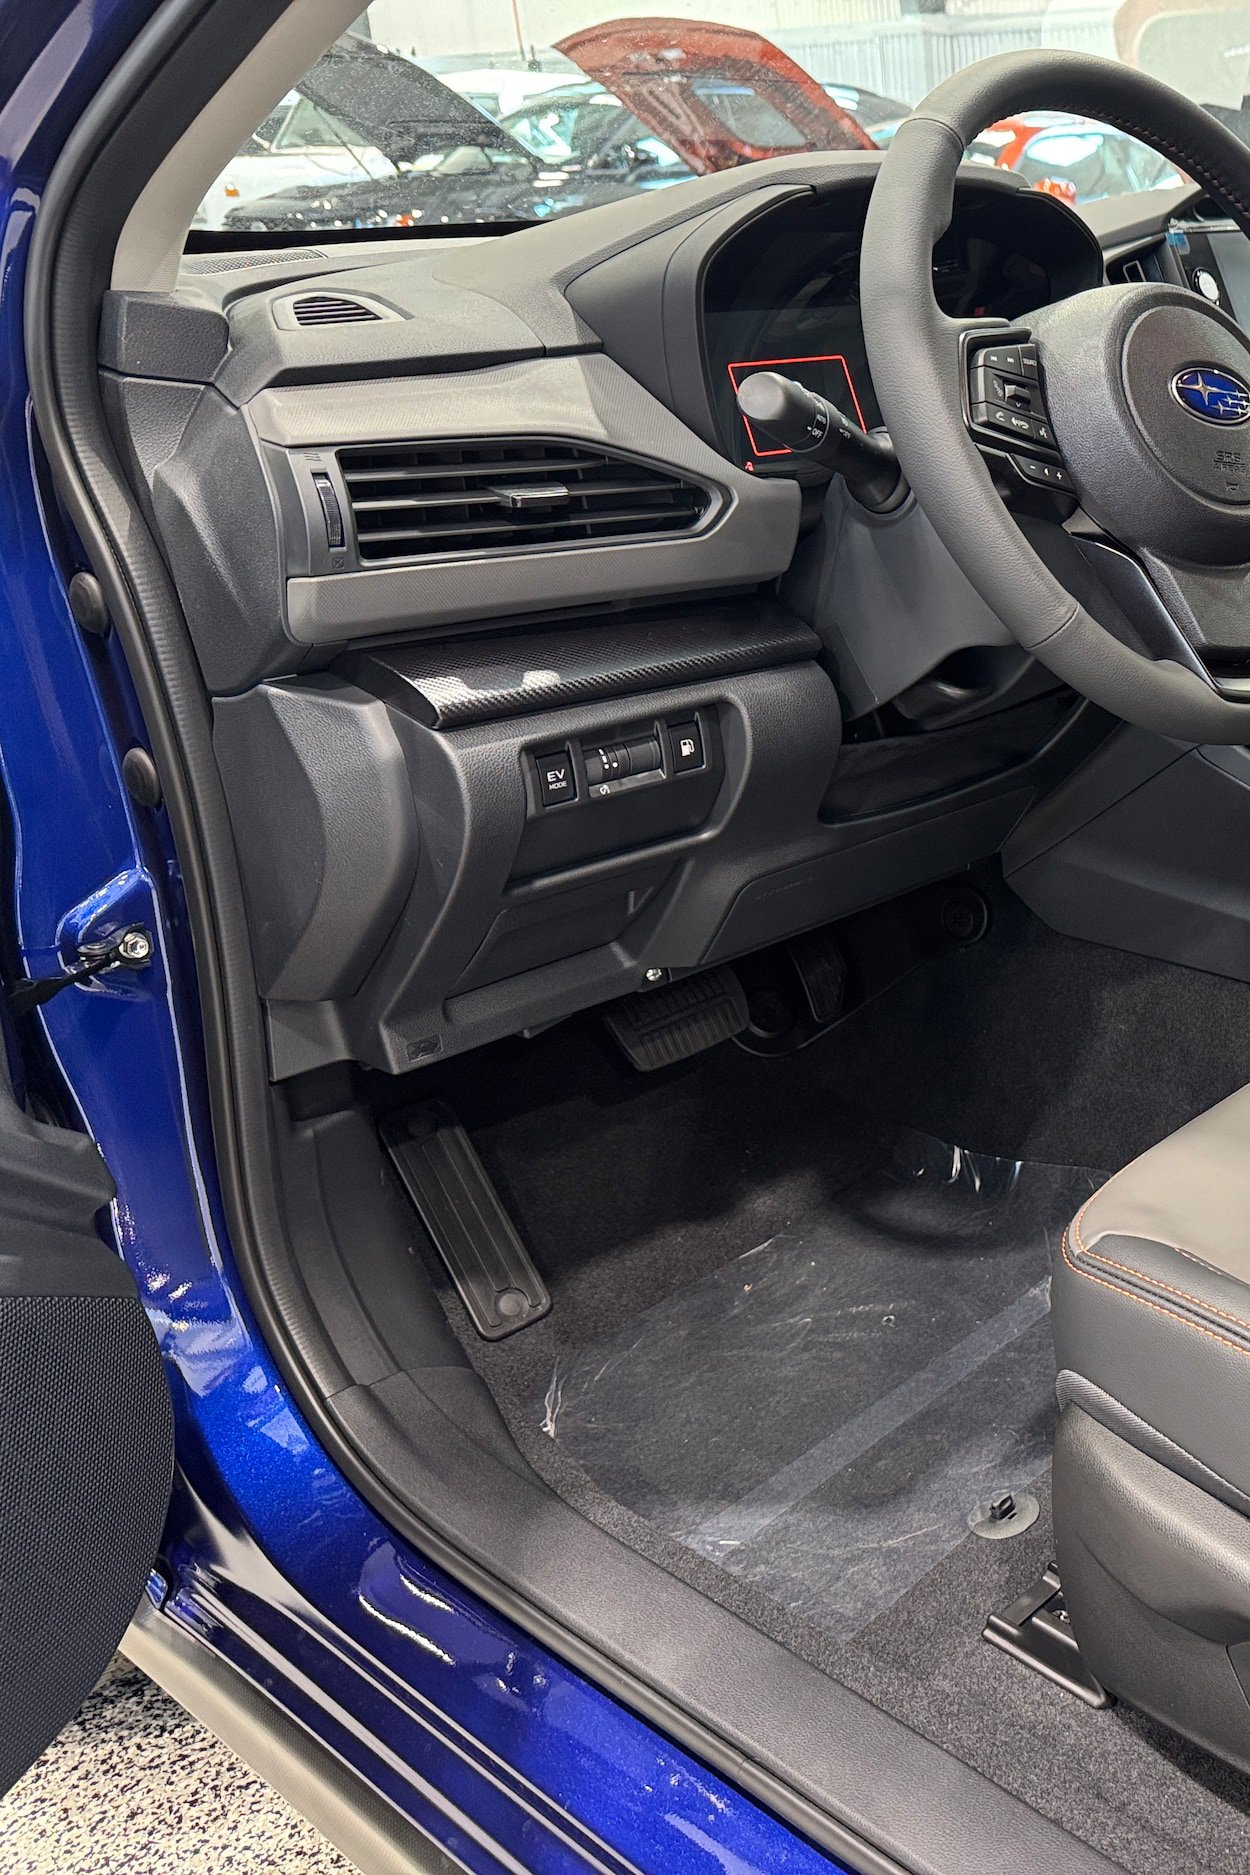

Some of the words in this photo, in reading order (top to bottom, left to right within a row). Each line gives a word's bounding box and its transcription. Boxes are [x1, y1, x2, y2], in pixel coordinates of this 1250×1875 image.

[812, 428, 824, 439] OFF
[1215, 450, 1242, 463] SRS
[546, 768, 566, 783] EV
[548, 780, 568, 791] MODE
